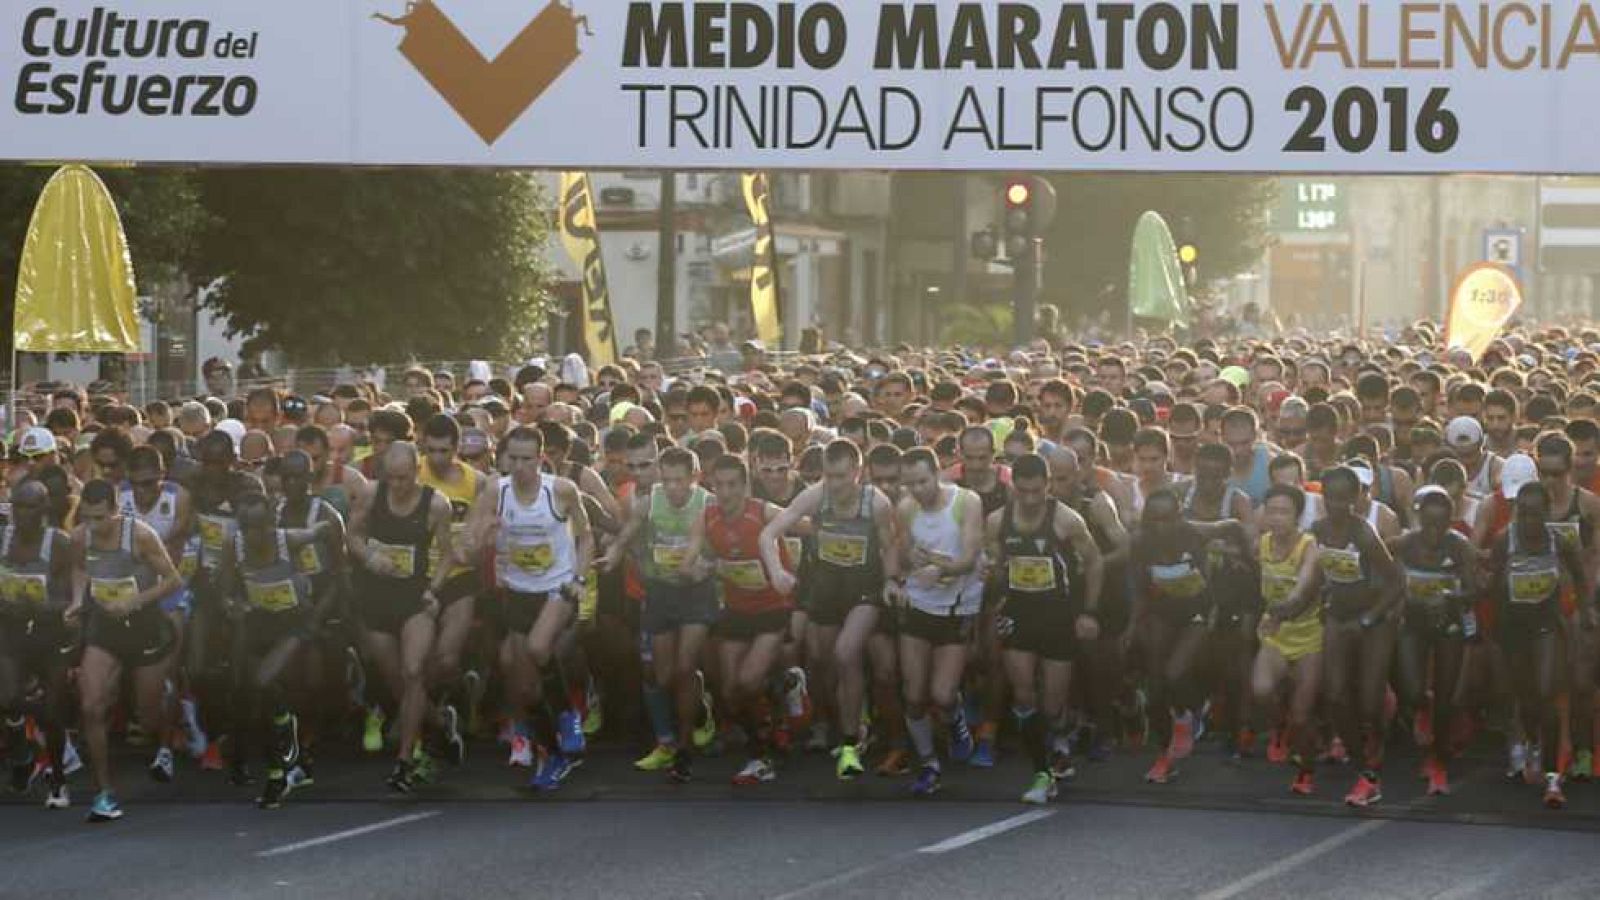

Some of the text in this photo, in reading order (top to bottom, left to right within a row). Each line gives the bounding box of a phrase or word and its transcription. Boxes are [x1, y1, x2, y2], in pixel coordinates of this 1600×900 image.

[22, 7, 258, 59] Cultura del
[622, 2, 1600, 71] MEDIO MARATON VALENCIA
[14, 61, 258, 116] Esfuerzo
[621, 84, 1459, 153] TRINIDAD ALFONSO 2016
